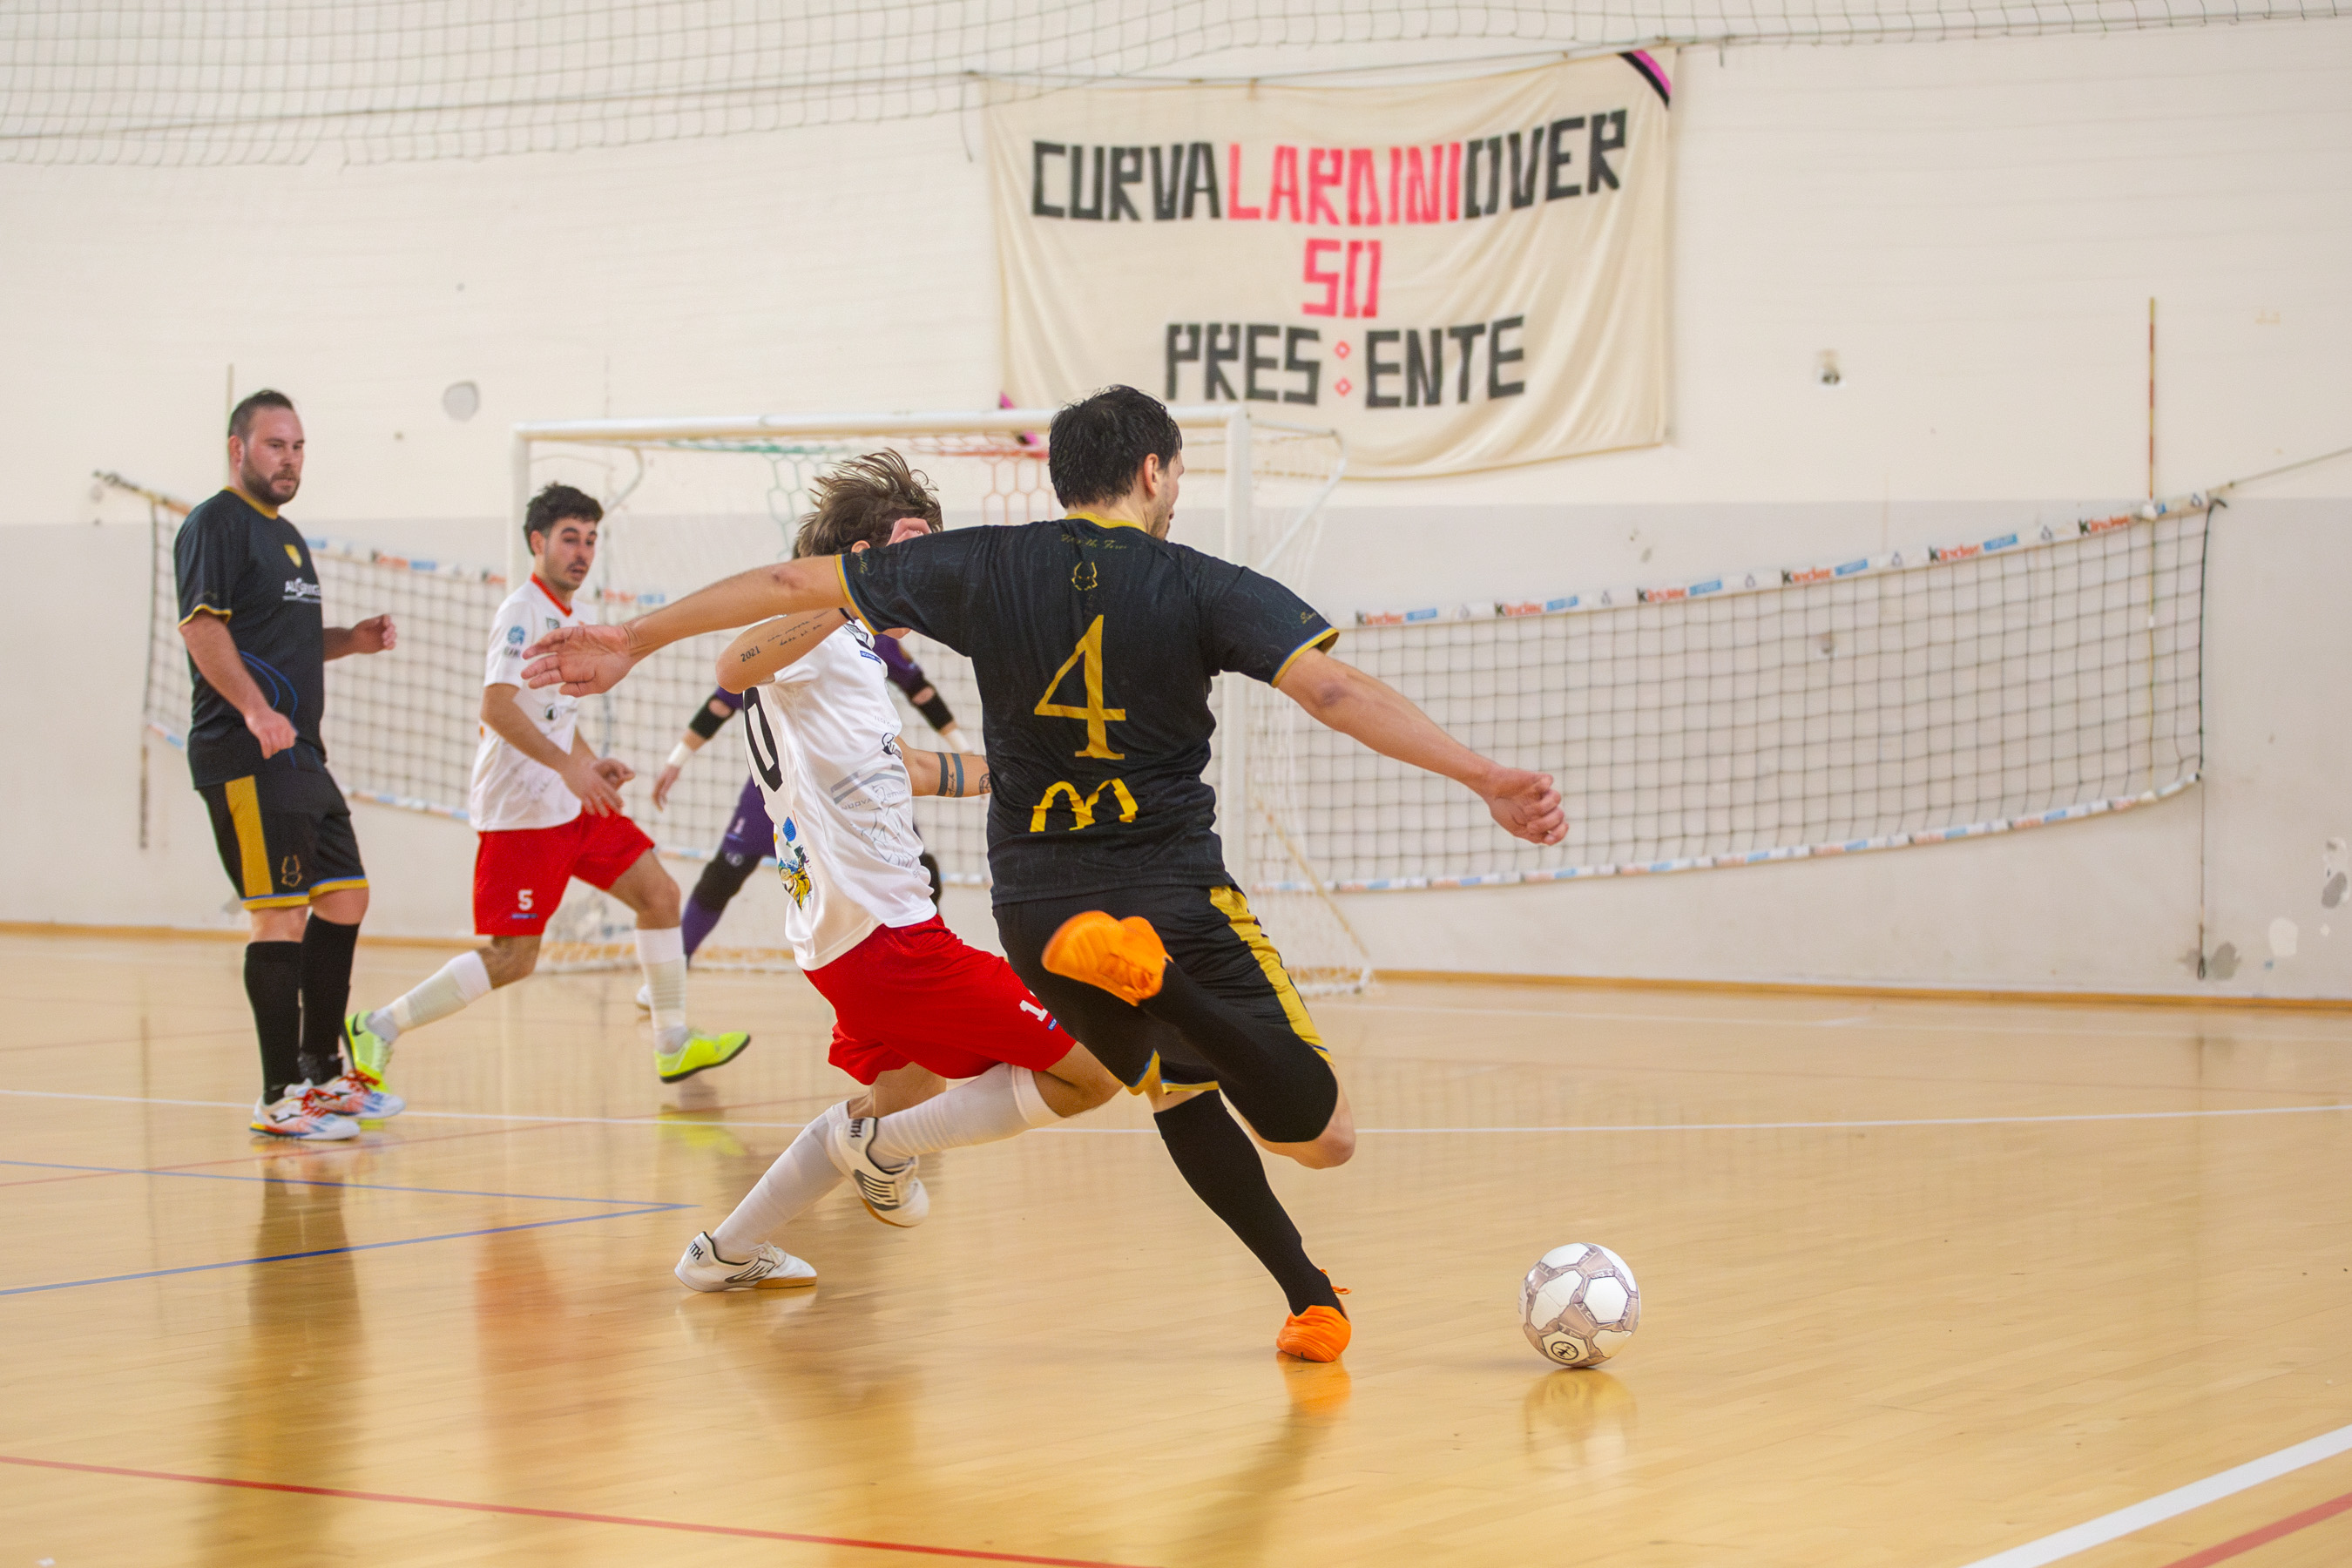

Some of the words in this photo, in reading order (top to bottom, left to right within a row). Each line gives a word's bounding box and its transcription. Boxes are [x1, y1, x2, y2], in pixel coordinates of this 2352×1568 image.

[740, 645, 761, 663] 2021
[1033, 614, 1126, 760] 4
[517, 889, 534, 911] 5
